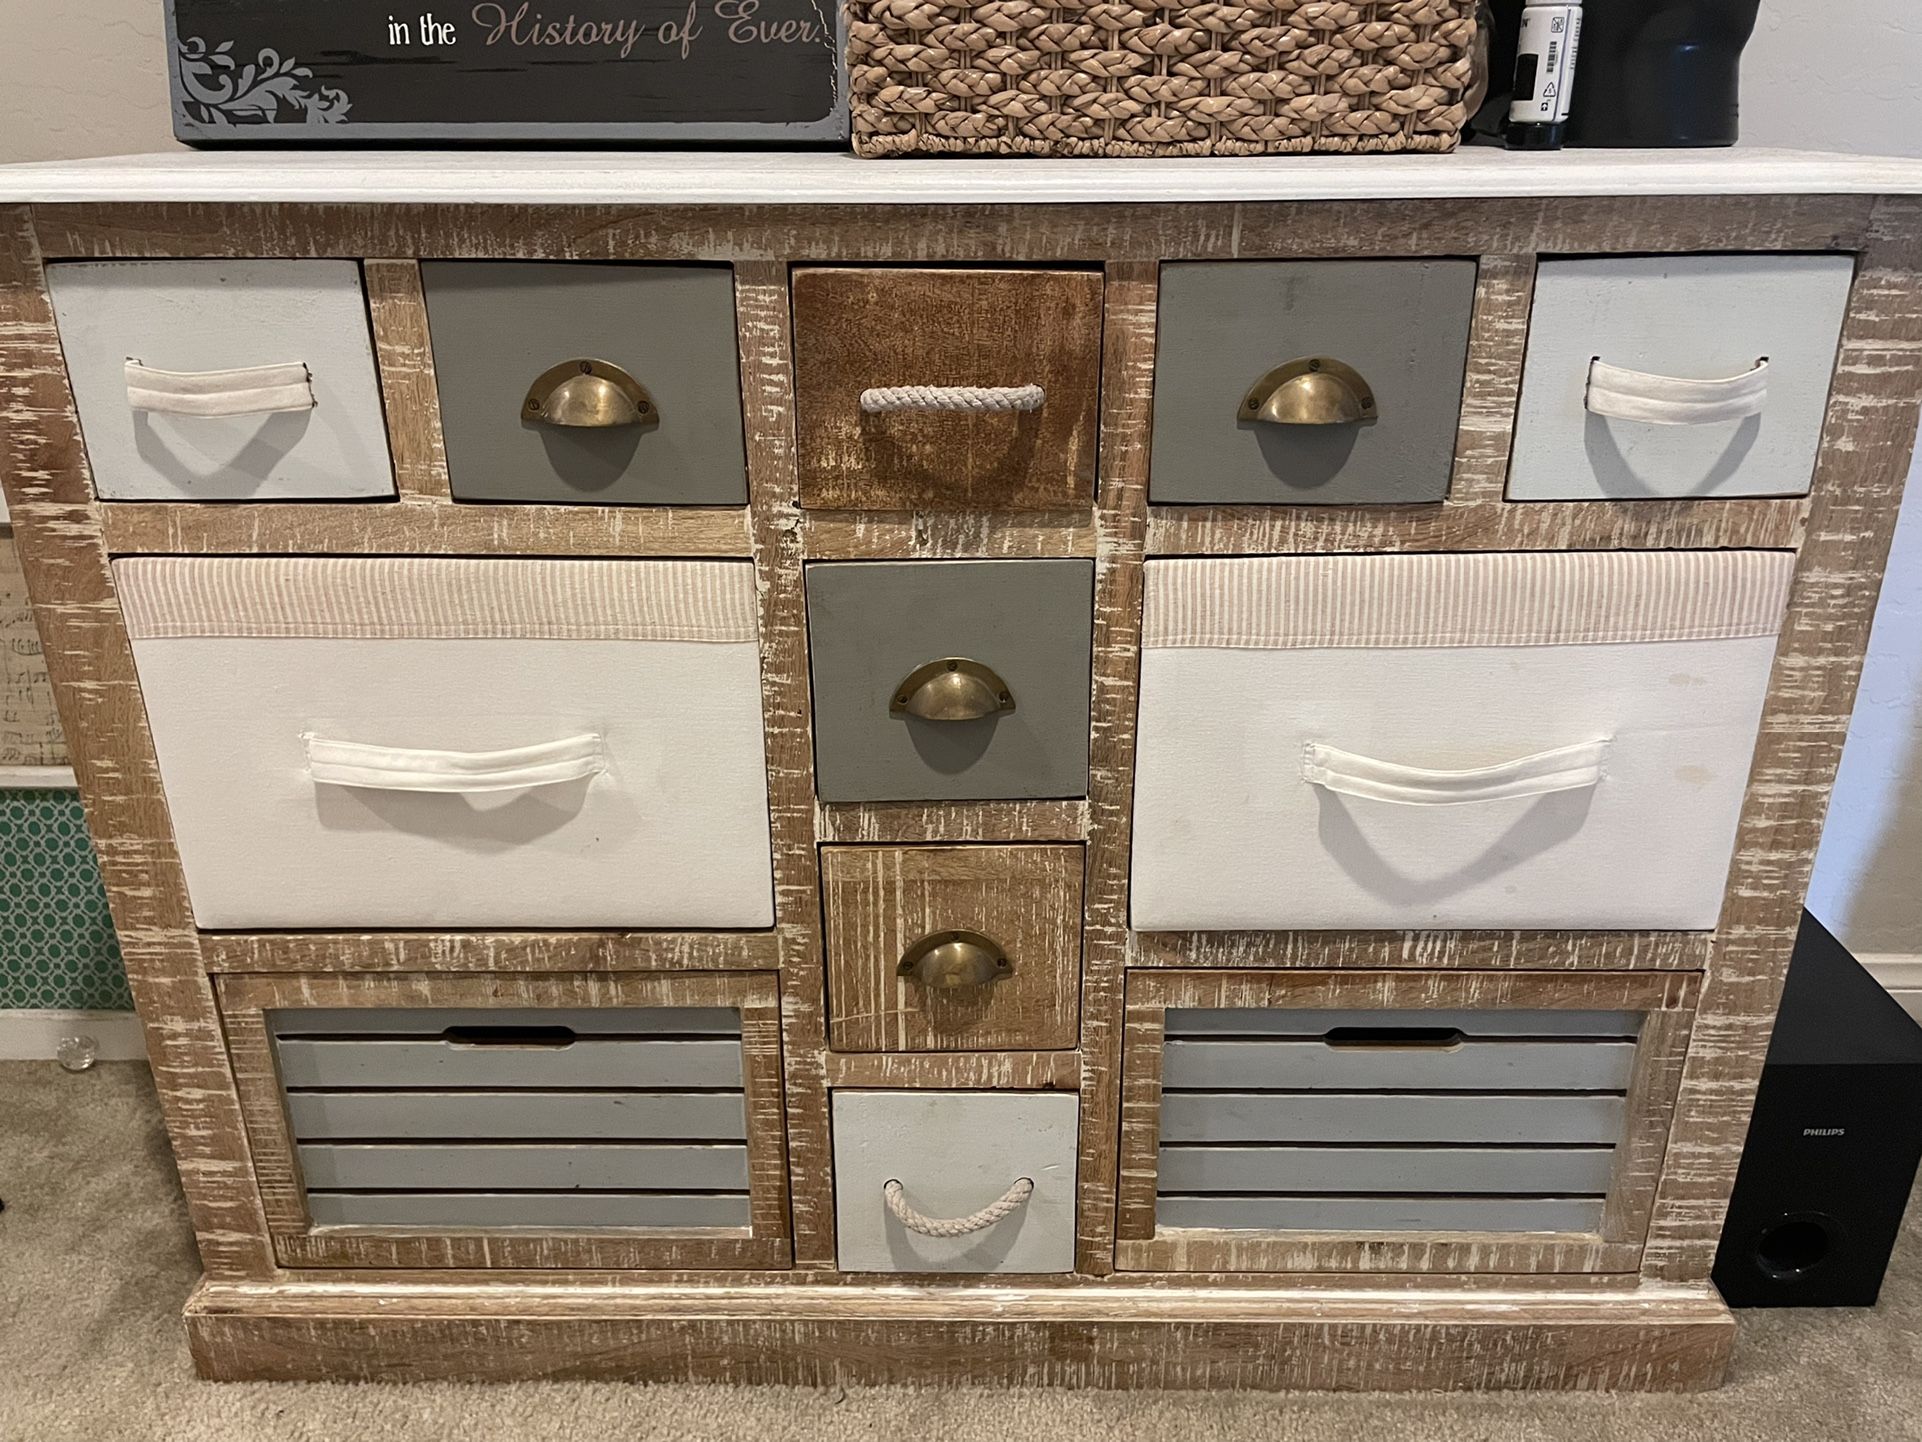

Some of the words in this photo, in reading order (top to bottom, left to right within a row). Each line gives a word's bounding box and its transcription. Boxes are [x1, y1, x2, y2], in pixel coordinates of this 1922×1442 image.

[388, 15, 410, 45] in
[419, 13, 456, 45] the
[472, 2, 645, 59] History
[658, 0, 703, 60] of
[714, 0, 821, 44] Ever.
[1802, 1128, 1846, 1137] PHILIPS
